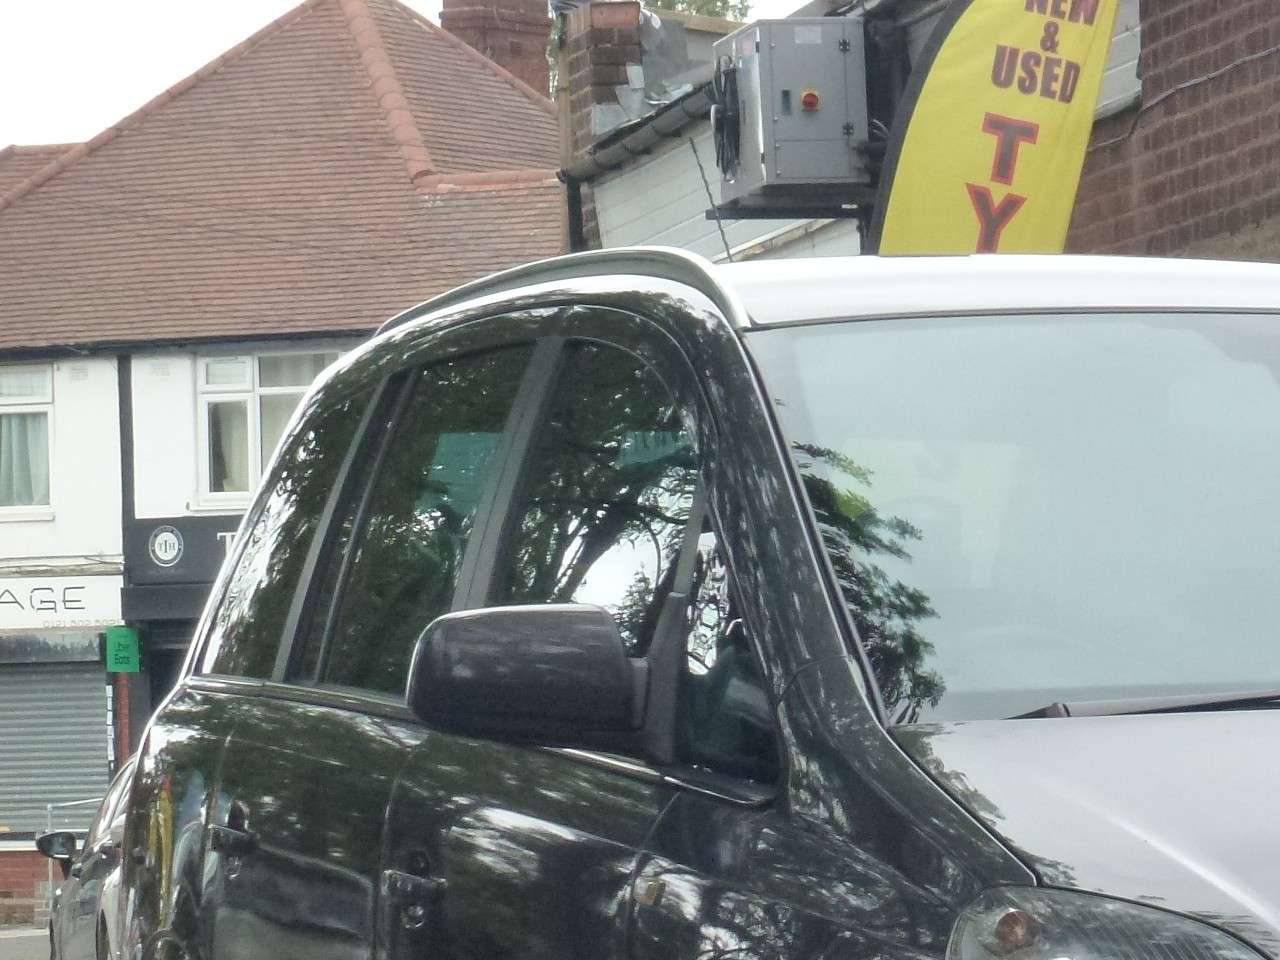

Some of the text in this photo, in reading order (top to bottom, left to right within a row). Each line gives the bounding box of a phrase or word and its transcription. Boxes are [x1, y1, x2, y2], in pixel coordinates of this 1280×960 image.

[1040, 21, 1059, 53] &
[991, 45, 1080, 104] USED
[0, 586, 86, 613] AGE
